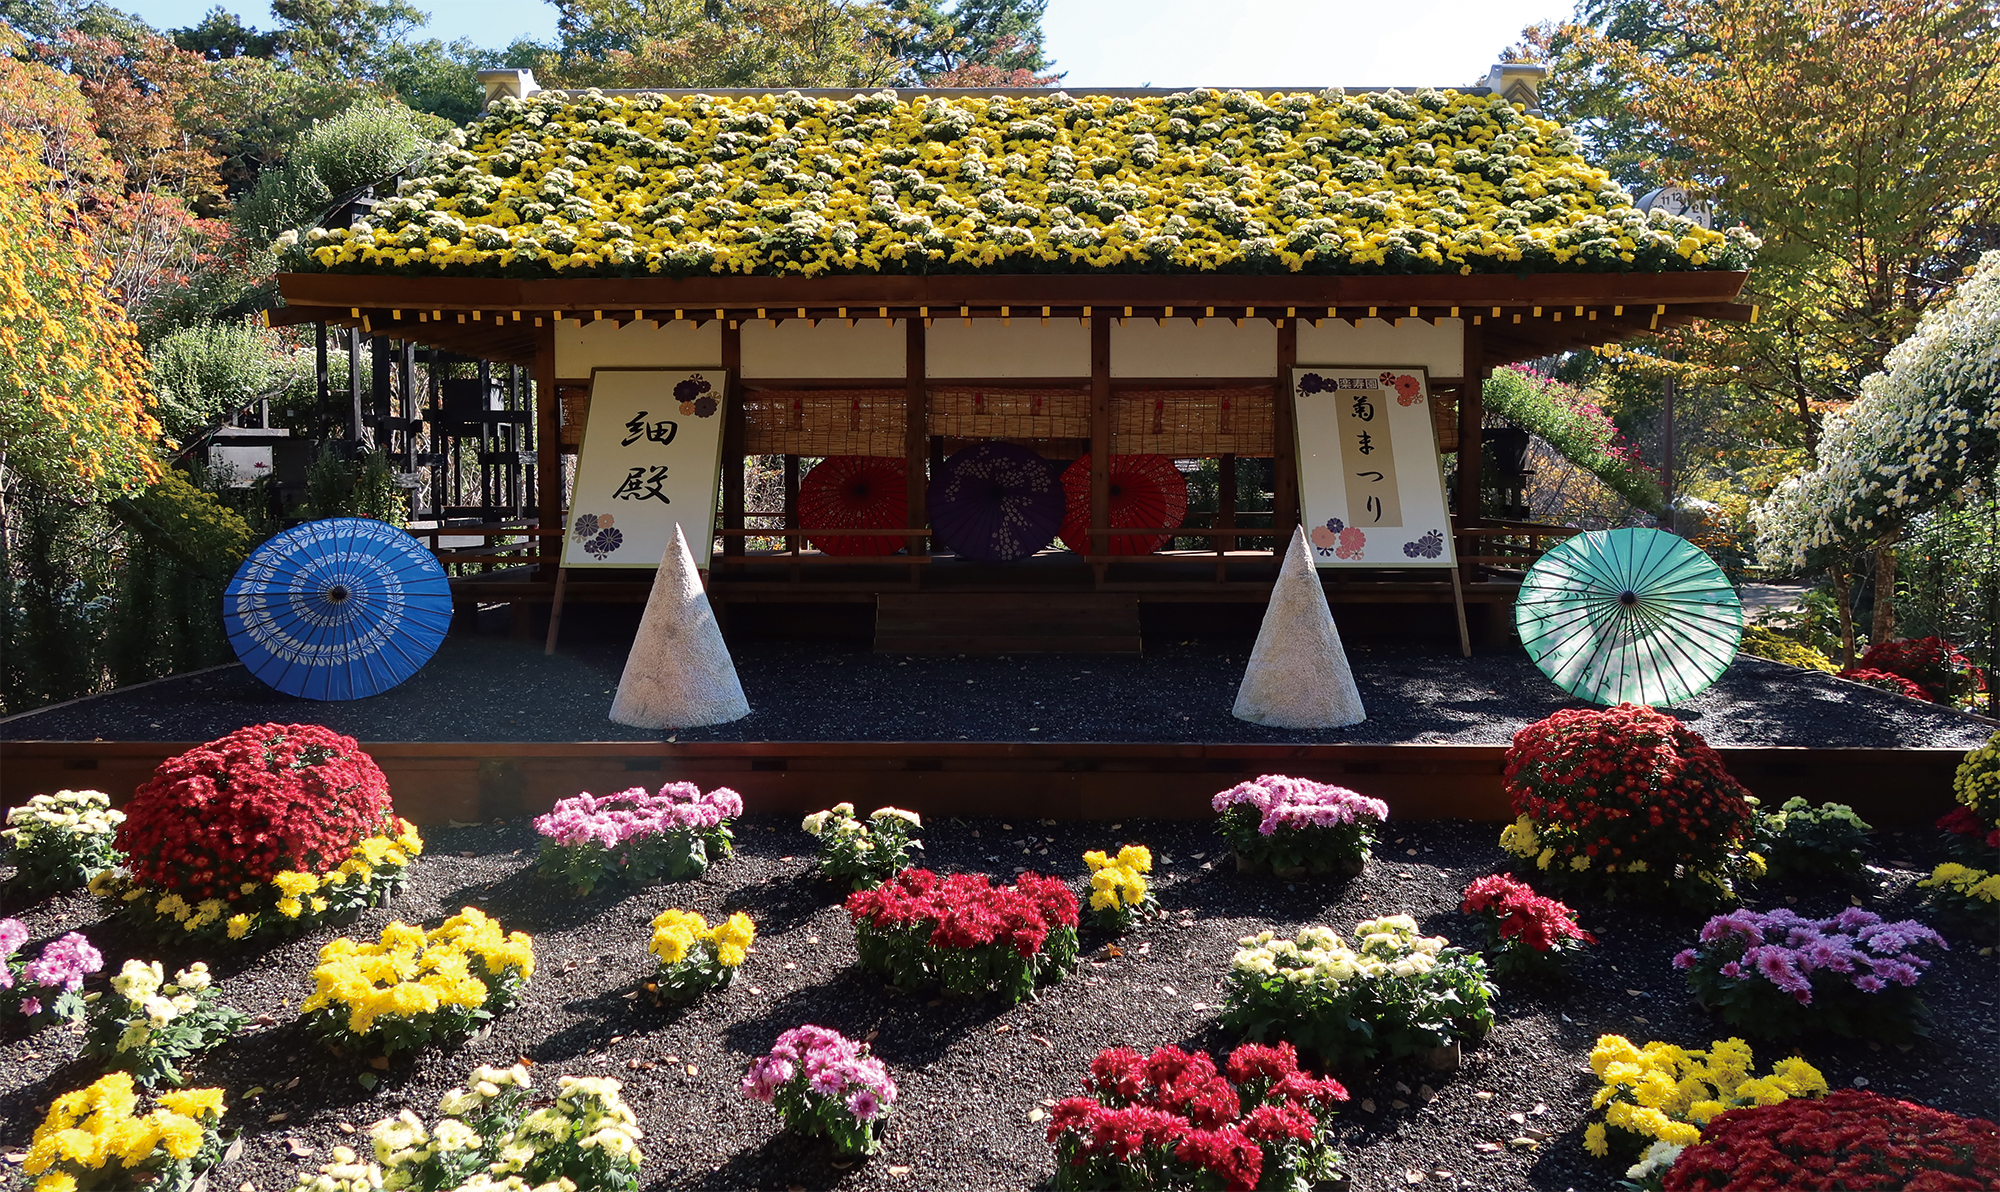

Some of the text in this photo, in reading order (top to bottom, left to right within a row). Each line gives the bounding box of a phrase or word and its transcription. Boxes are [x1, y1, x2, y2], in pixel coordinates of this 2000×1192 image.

[1661, 196, 1670, 205] 11
[1671, 192, 1682, 202] 12
[1695, 215, 1703, 226] 3
[612, 411, 678, 505] 細殿
[1351, 396, 1384, 523] 菊まつり
